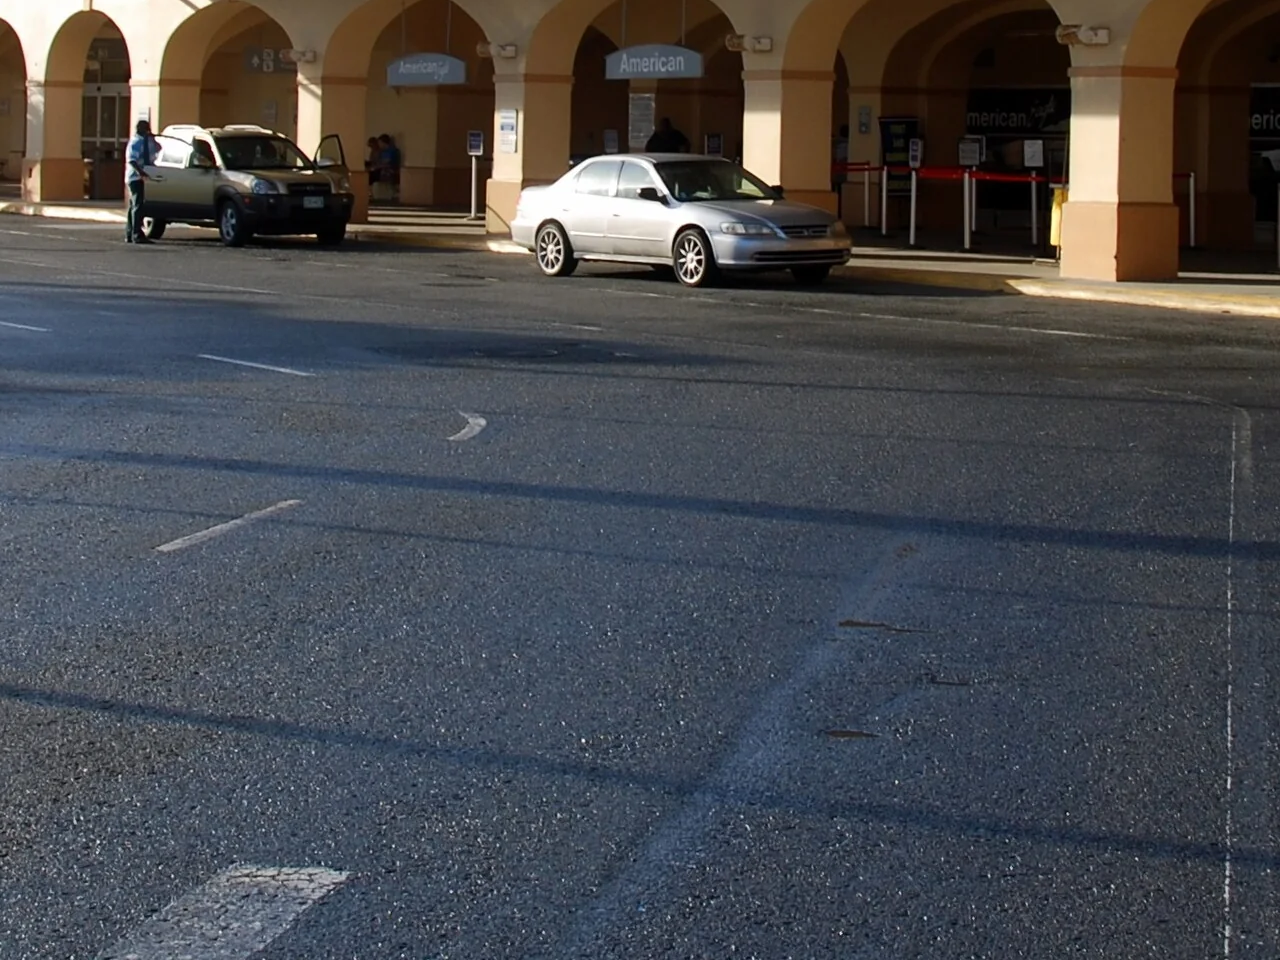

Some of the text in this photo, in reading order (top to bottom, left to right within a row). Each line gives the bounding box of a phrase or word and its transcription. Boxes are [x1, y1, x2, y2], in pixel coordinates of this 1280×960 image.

[398, 59, 438, 75] American
[619, 51, 685, 74] American
[966, 107, 1027, 128] merican
